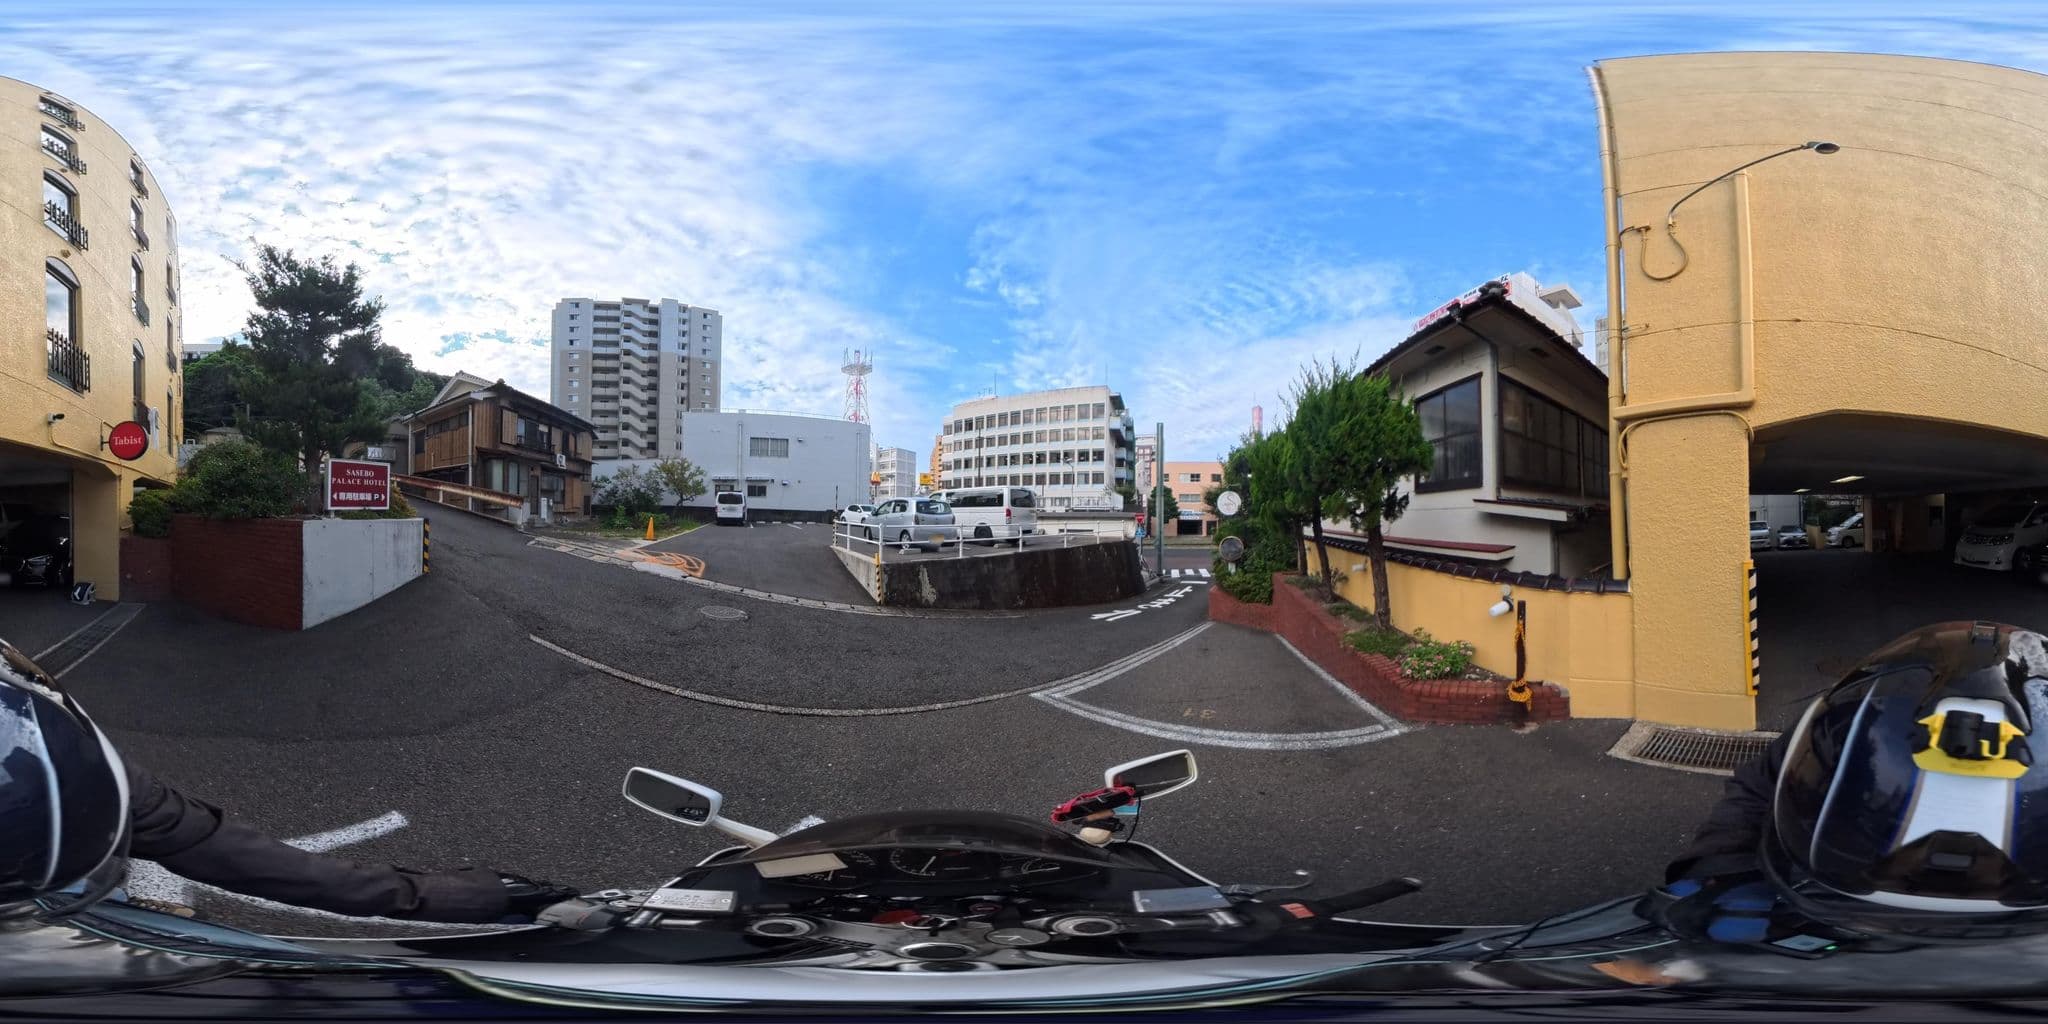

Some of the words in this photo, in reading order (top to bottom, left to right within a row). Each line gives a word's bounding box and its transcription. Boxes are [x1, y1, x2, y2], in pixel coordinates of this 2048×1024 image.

[113, 436, 142, 446] Tabist
[346, 469, 375, 477] SASEBO
[332, 477, 362, 485] PALACE
[363, 479, 387, 487] HOTEL
